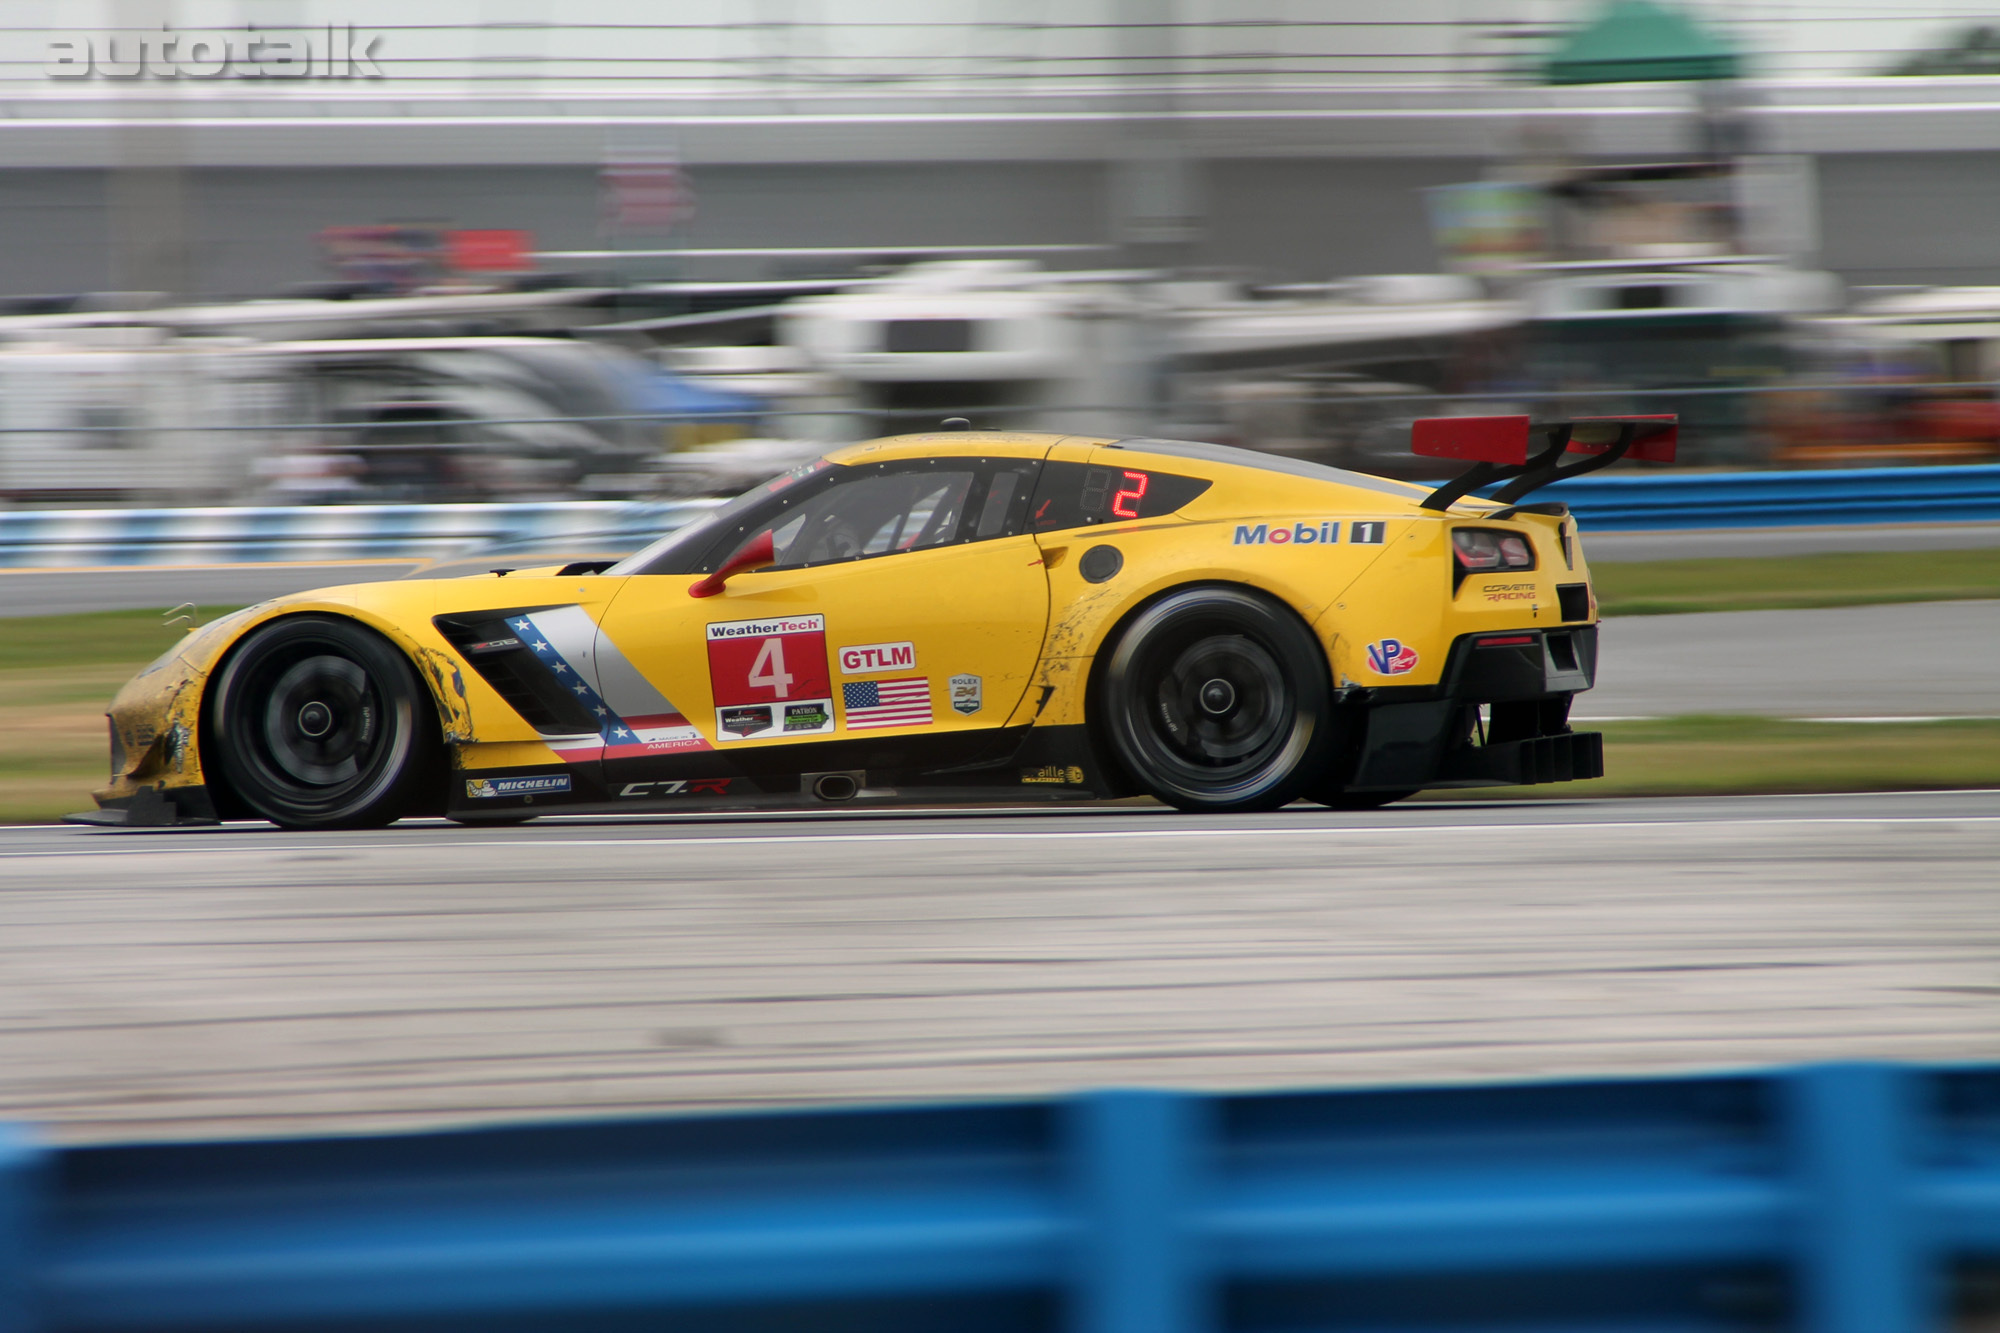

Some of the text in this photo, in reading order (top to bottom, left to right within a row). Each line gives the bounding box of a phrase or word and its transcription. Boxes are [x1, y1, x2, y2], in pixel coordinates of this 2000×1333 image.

[1113, 471, 1148, 518] 2
[1233, 522, 1340, 545] Mobil
[1483, 584, 1536, 592] CORVETTE
[1483, 592, 1536, 602] RACING
[711, 619, 819, 637] WeatherTech
[843, 647, 912, 669] GTLM
[1367, 639, 1401, 674] VP
[748, 638, 794, 698] 4
[954, 686, 977, 697] 24
[647, 739, 701, 750] AMERICA
[498, 778, 568, 790] MICHELIN
